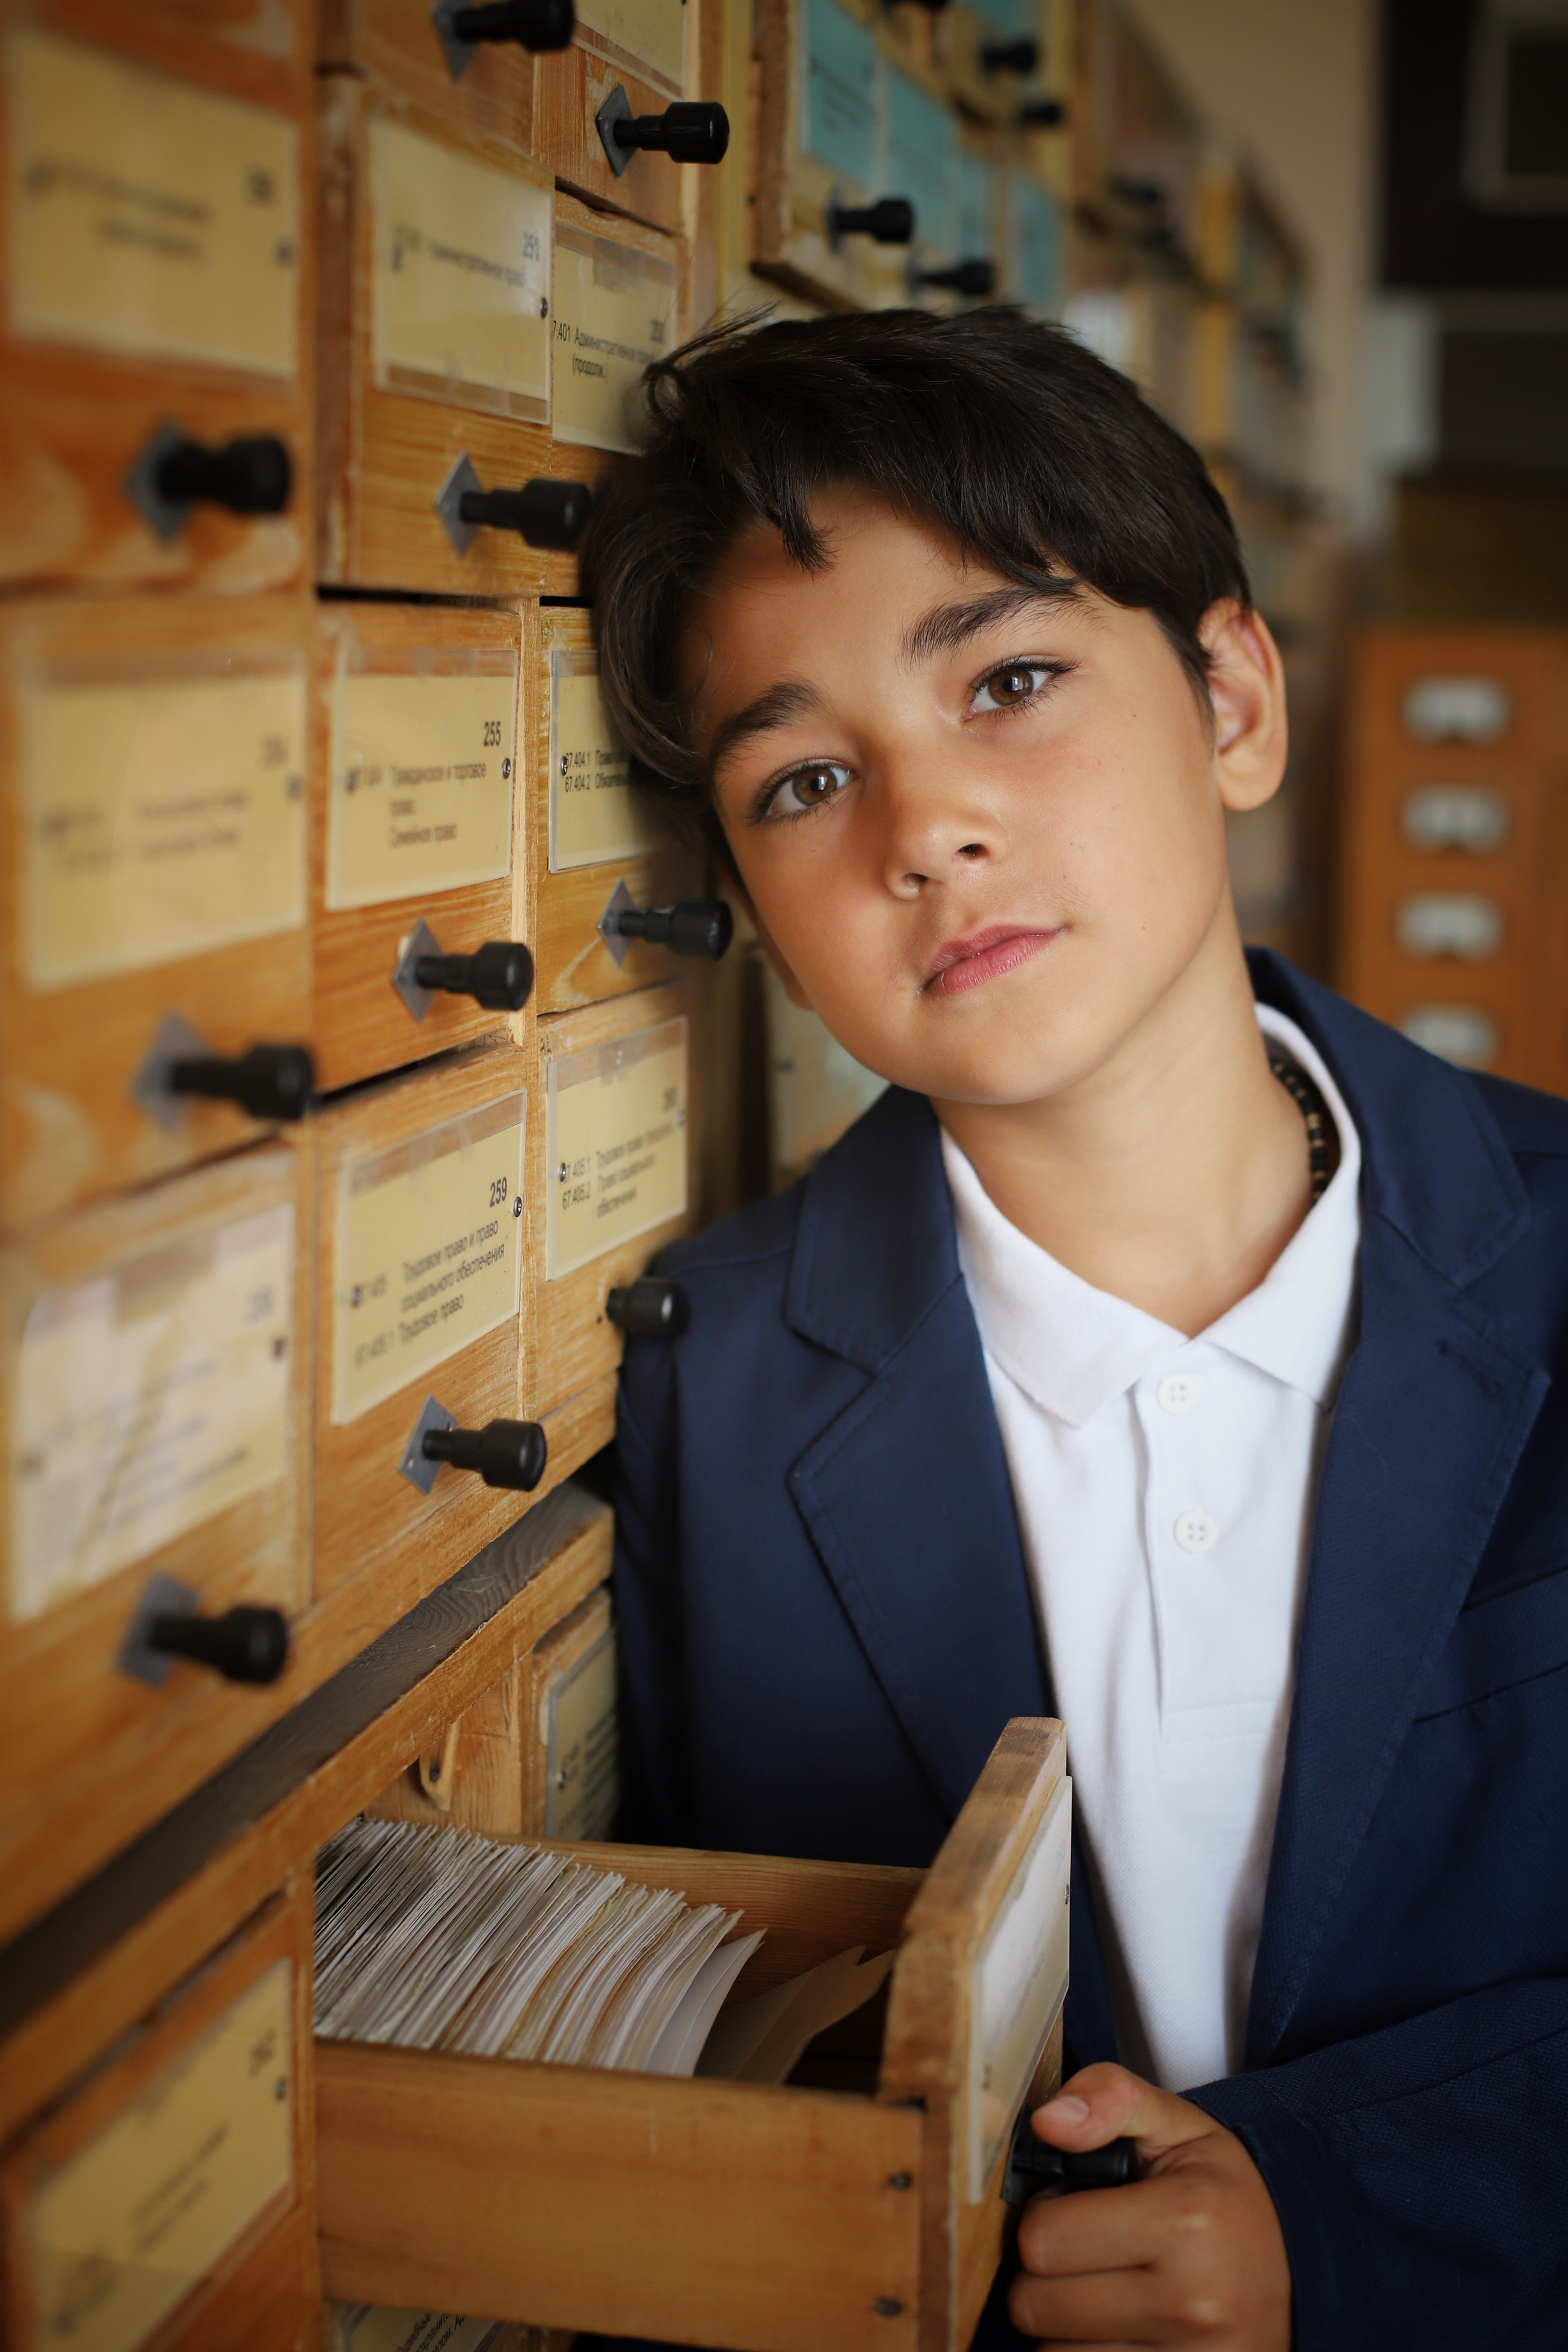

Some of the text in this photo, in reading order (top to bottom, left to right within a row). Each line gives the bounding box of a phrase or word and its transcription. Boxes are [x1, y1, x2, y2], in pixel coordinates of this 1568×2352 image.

[483, 721, 502, 747] 255
[565, 775, 590, 792] 67.404.2
[566, 1158, 590, 1182] 7.405.1
[489, 1176, 508, 1208] 259
[563, 1183, 590, 1209] 67.405.2
[469, 1232, 477, 1248] и
[477, 1220, 499, 1247] право
[456, 1243, 505, 1283] обеспечения
